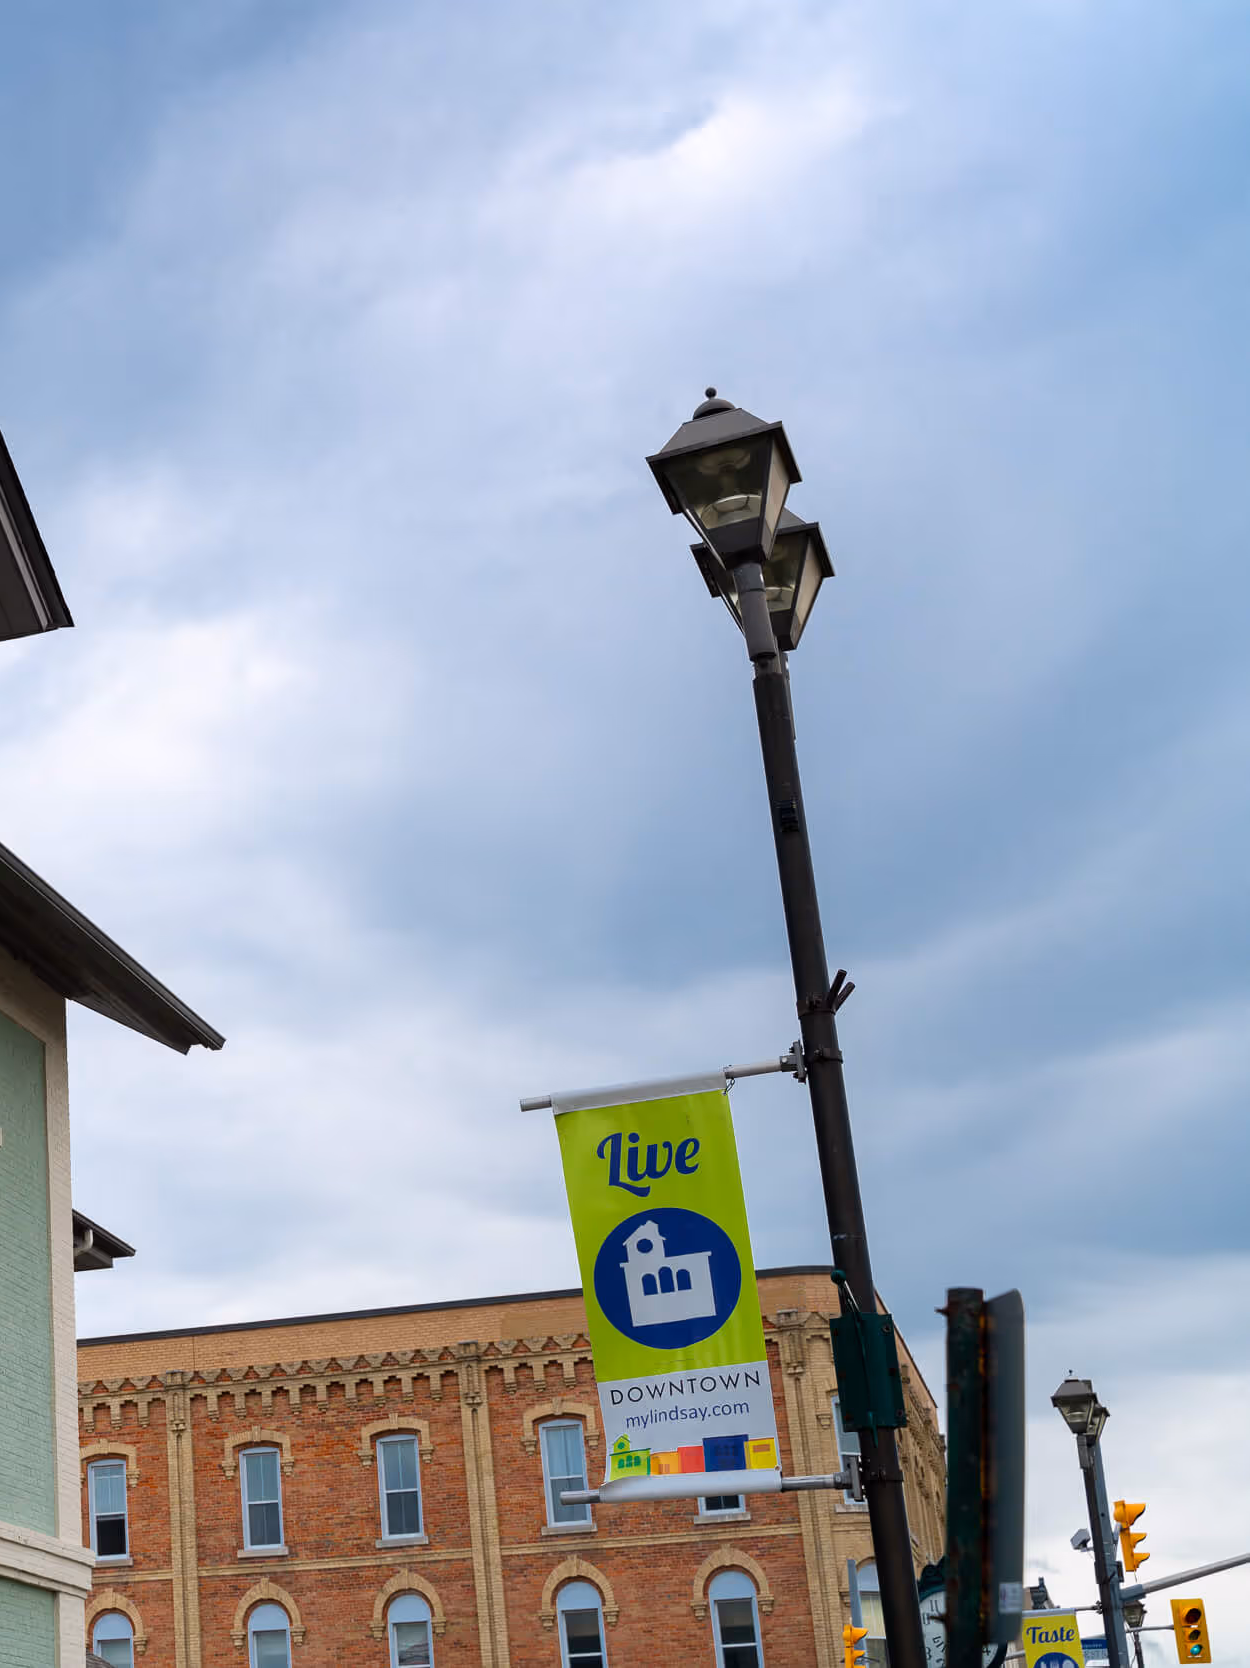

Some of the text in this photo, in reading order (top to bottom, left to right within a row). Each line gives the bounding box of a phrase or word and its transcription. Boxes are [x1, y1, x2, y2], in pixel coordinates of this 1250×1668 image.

[597, 1132, 700, 1197] Live
[610, 1371, 760, 1405] DOWNTOWN
[626, 1402, 750, 1428] mylindsay.com
[1026, 1627, 1075, 1644] Taste
